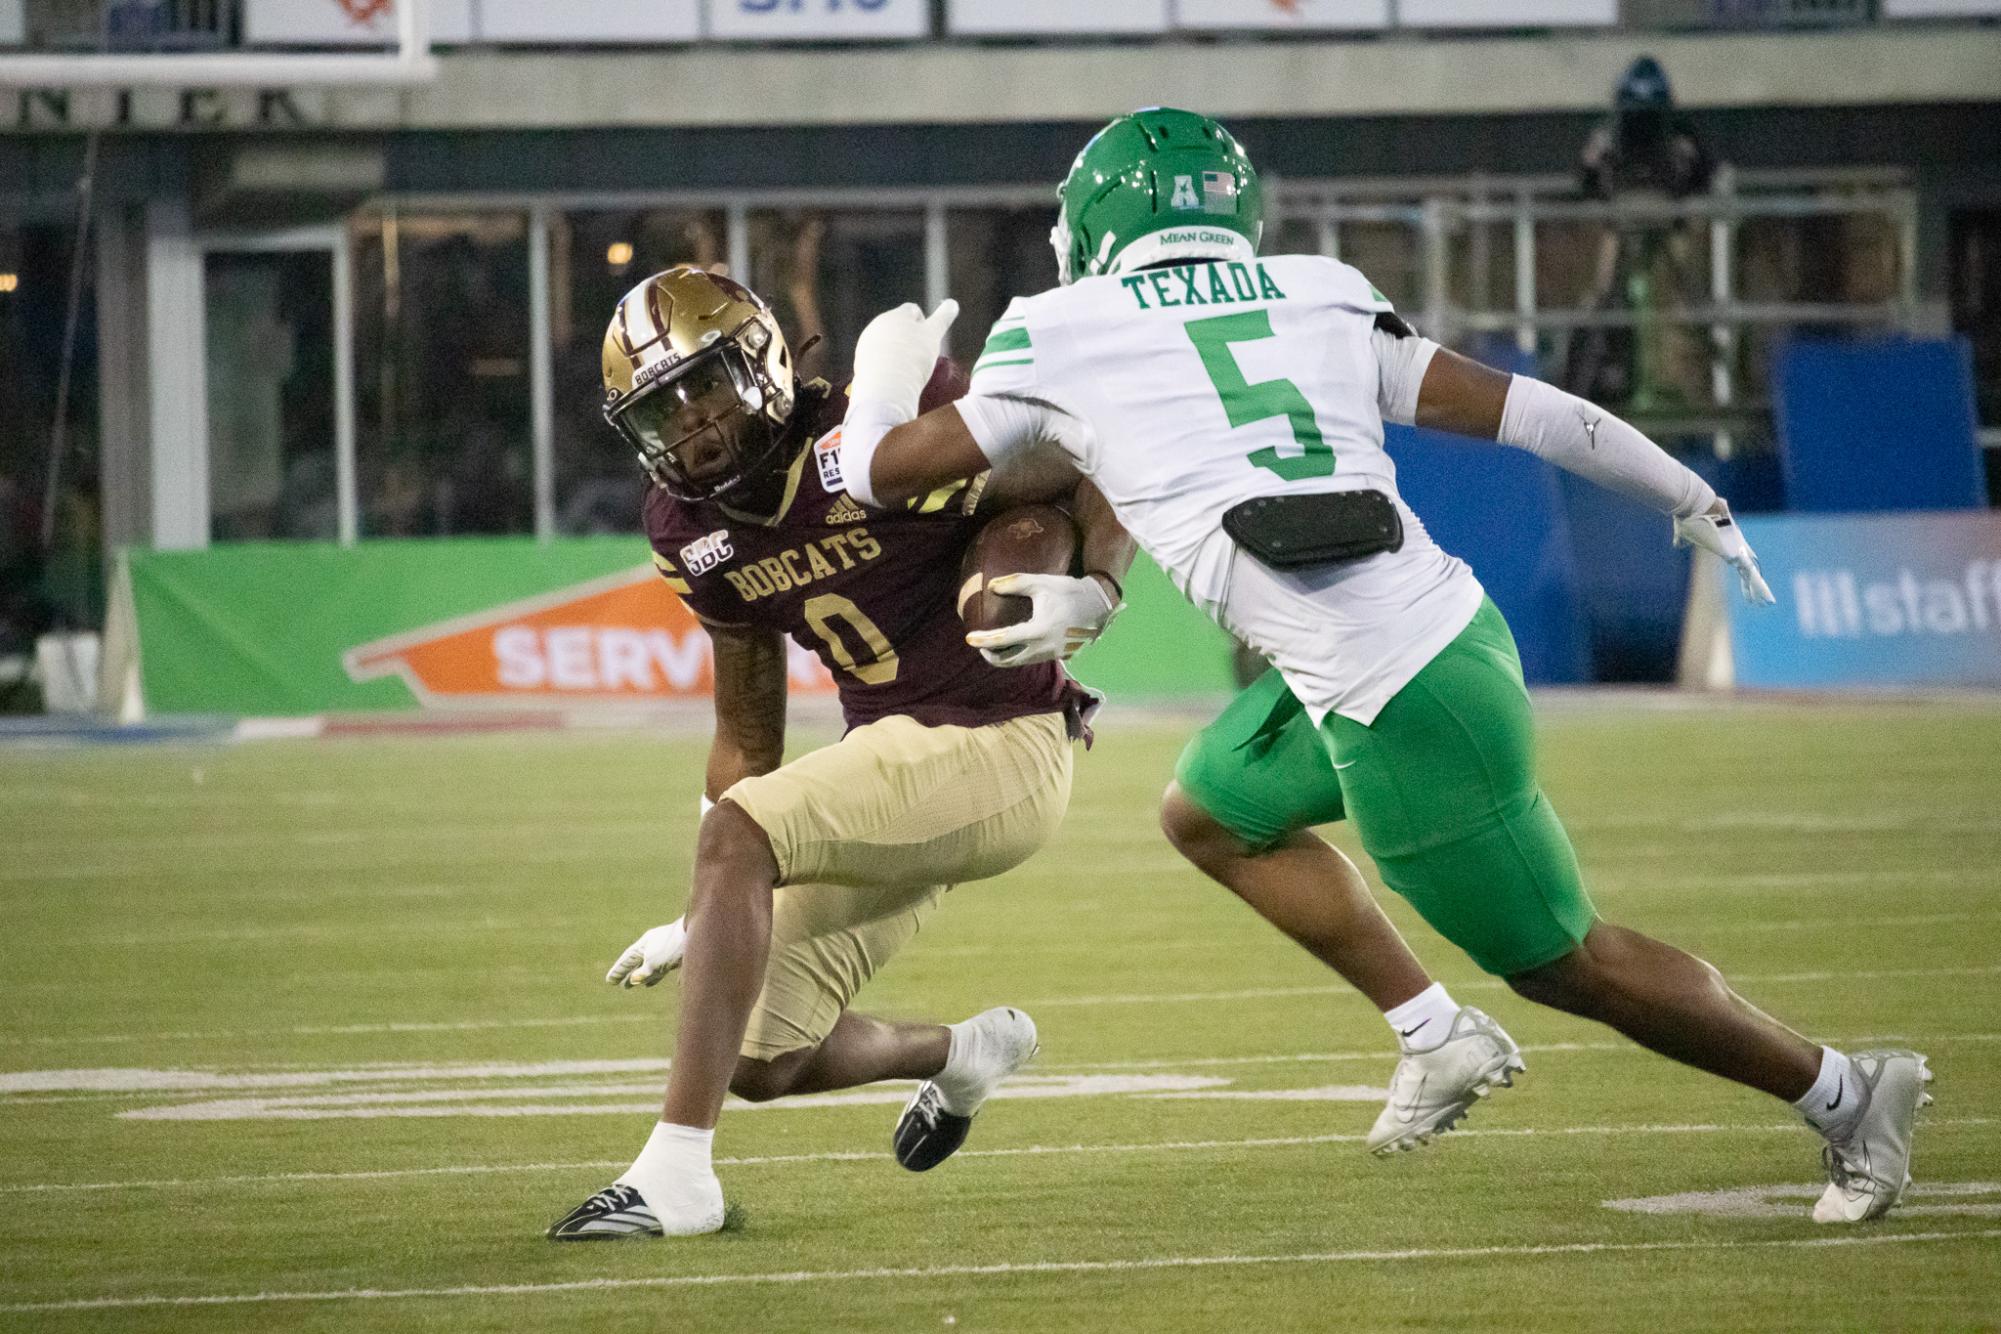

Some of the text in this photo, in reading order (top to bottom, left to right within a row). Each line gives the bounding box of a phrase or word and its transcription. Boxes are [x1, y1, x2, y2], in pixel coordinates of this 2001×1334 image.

[1160, 231, 1234, 245] MEAN GREEN
[1121, 262, 1287, 309] TEXADA
[634, 352, 682, 385] BOBCATS
[1184, 309, 1336, 481] 5
[826, 509, 867, 525] adidas
[724, 527, 882, 602] BOBCATS
[493, 626, 816, 690] SERV
[805, 592, 899, 685] 0
